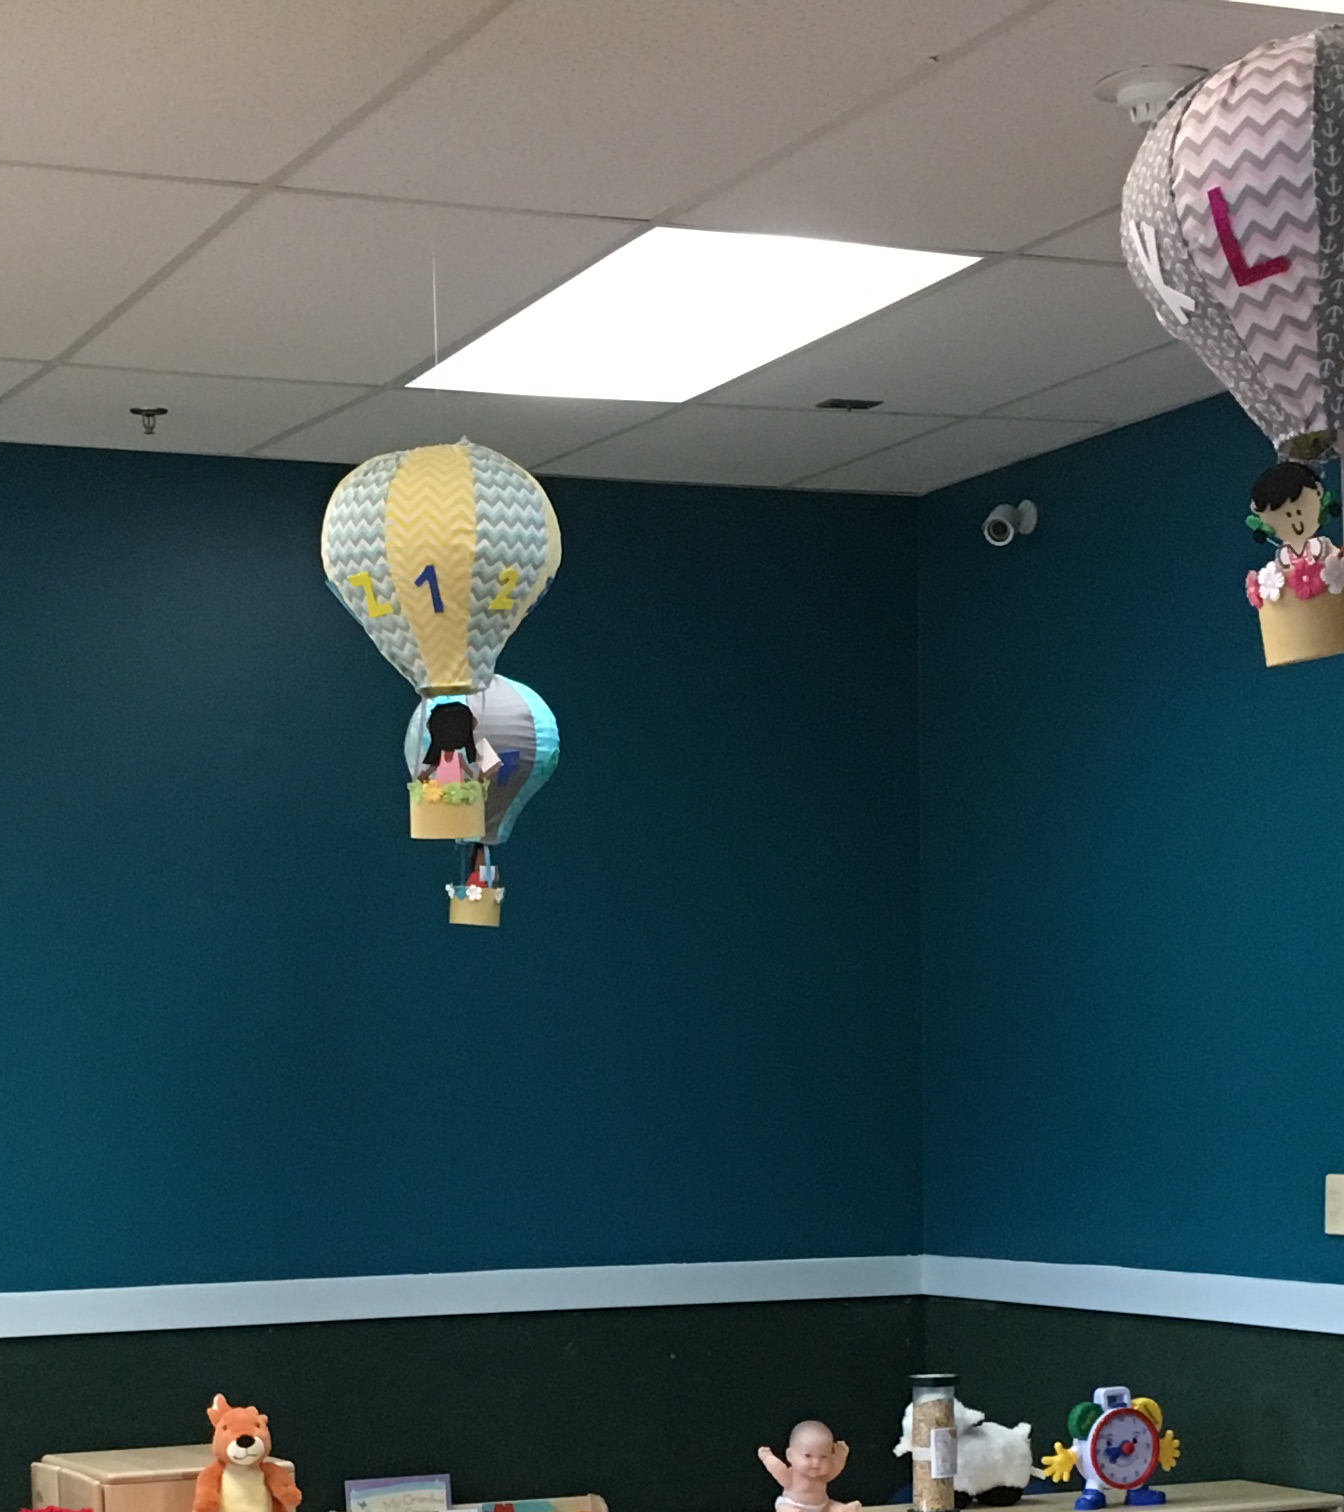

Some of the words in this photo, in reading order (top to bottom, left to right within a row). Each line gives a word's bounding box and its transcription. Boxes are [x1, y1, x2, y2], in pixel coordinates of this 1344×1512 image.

[1128, 219, 1196, 325] K
[1208, 186, 1292, 287] L
[414, 564, 444, 613] 1
[489, 568, 519, 611] 2
